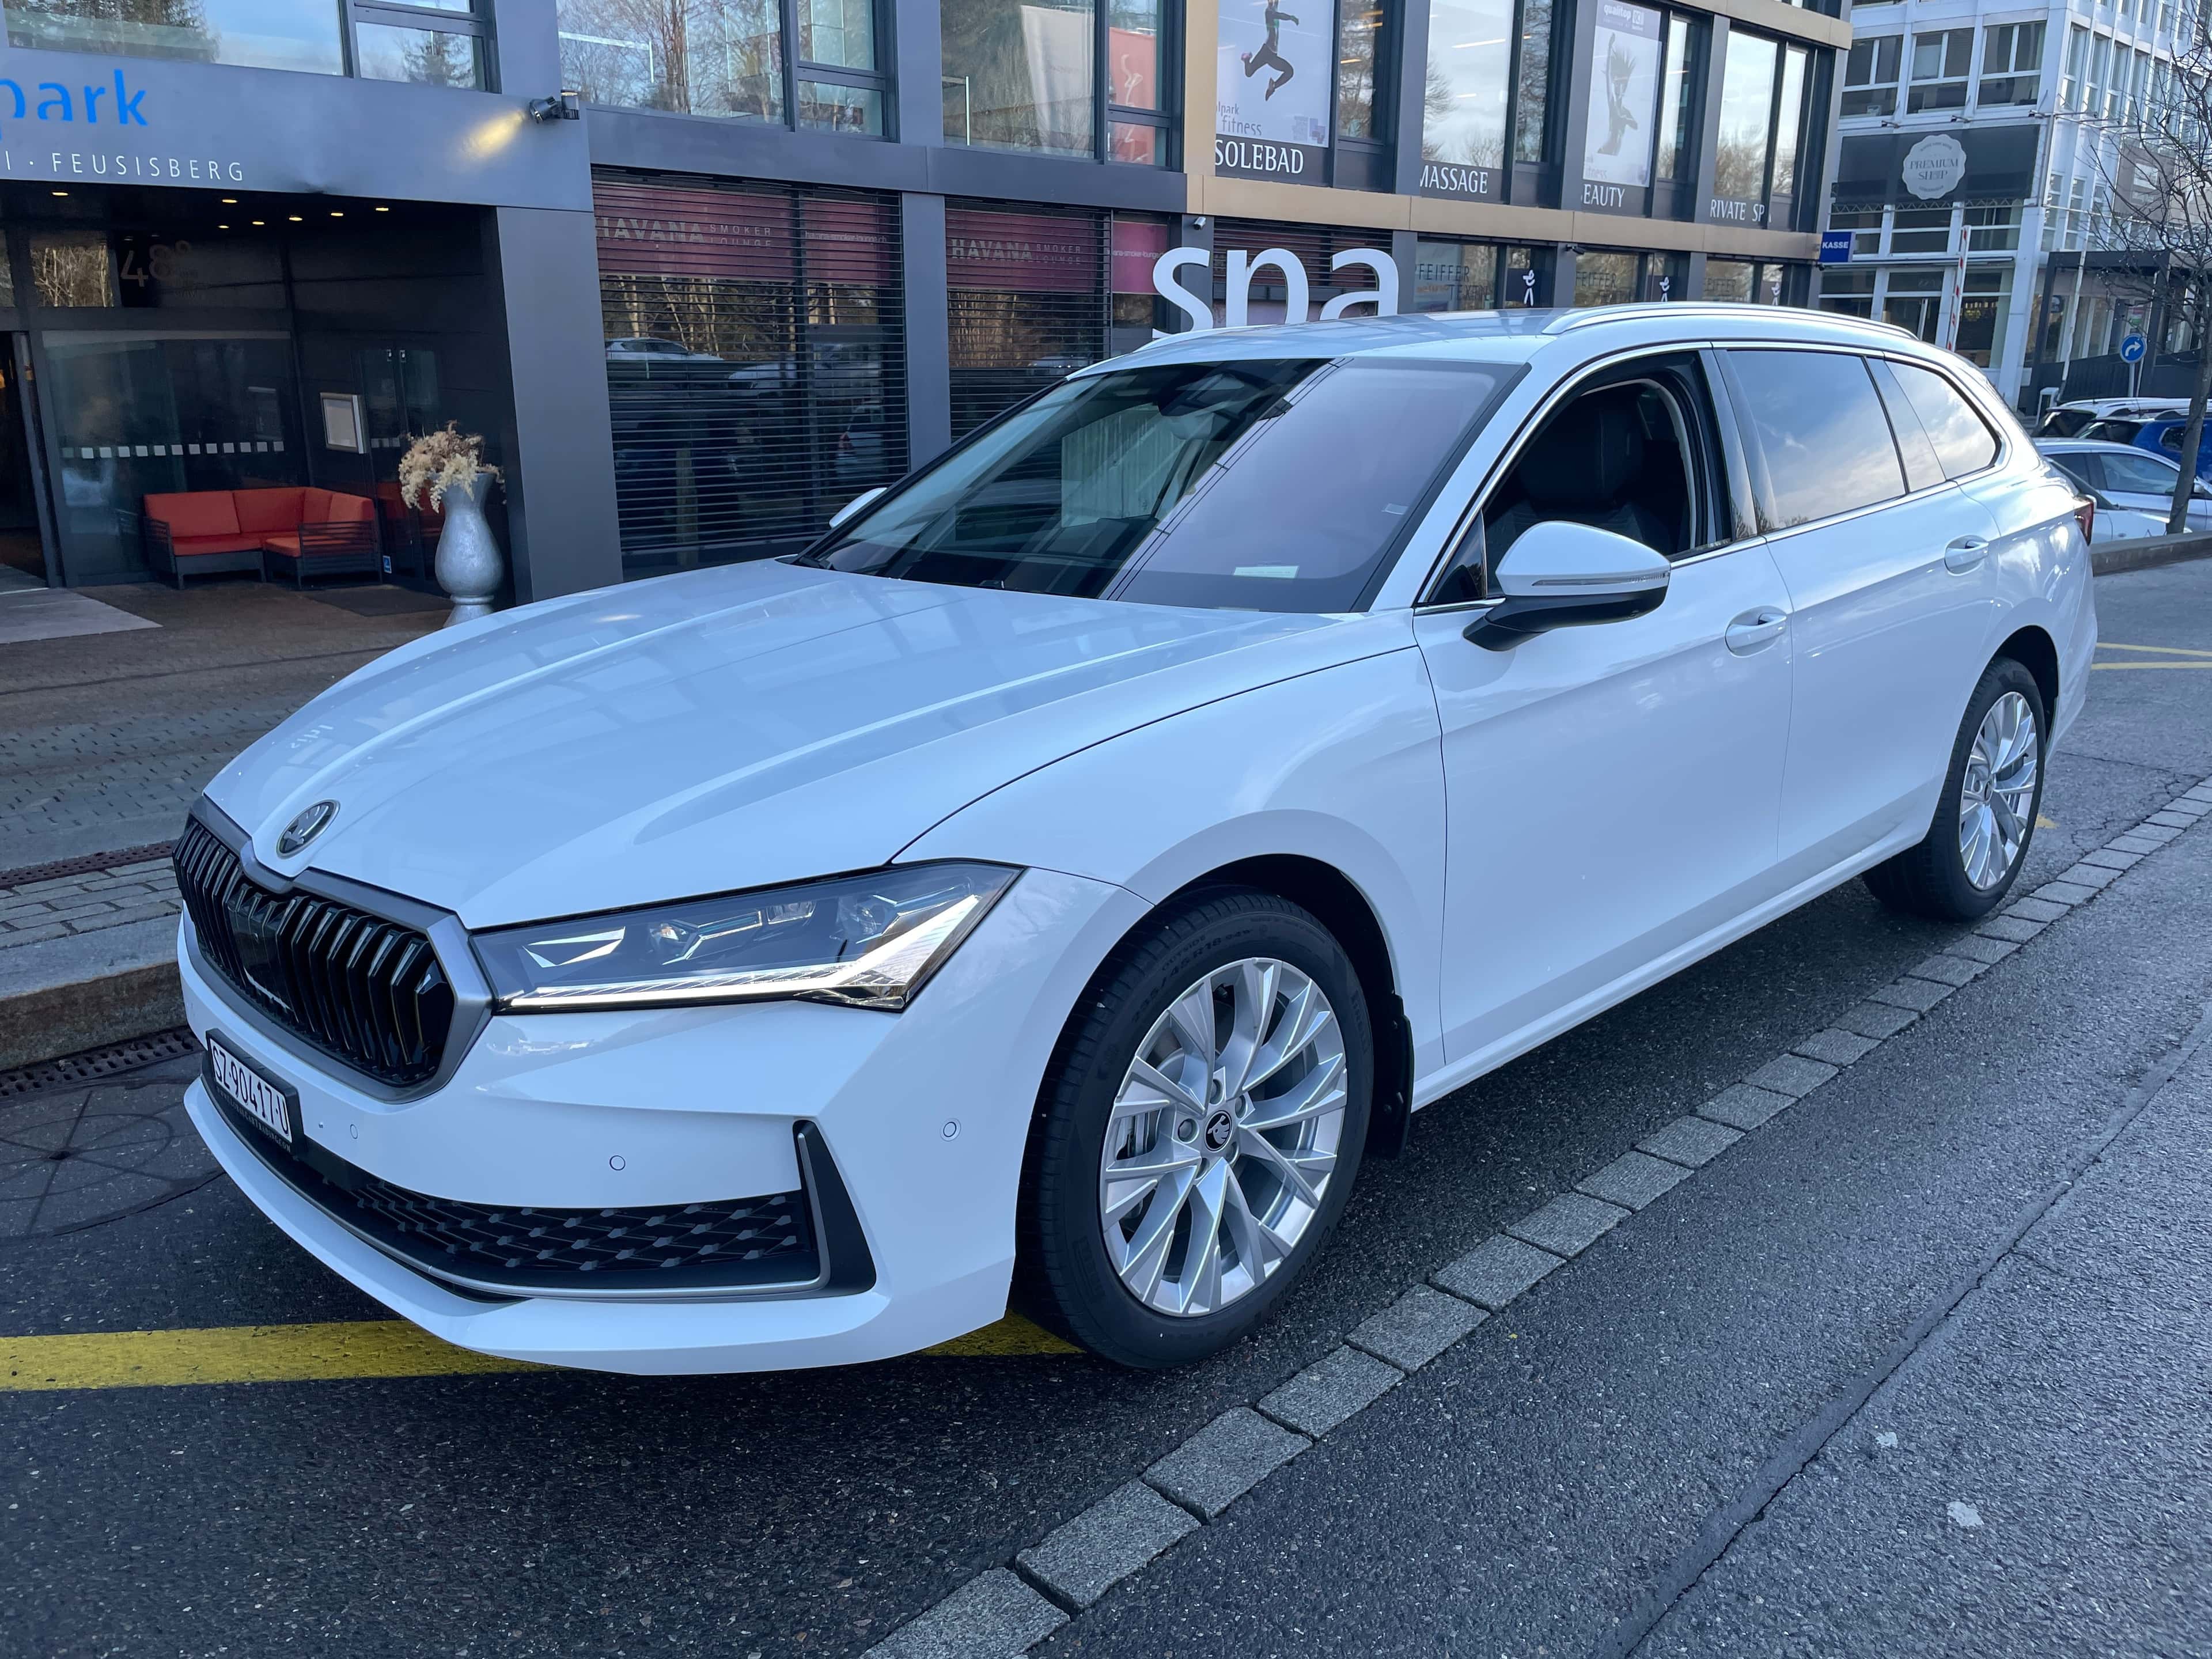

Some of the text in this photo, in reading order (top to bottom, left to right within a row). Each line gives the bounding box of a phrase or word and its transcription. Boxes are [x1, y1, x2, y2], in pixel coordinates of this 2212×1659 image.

[1222, 115, 1263, 136] fitness
[52, 152, 244, 181] FEUSISBERG
[1215, 139, 1304, 173] SOLEBAD
[1581, 184, 1626, 208] EAUTY
[1710, 199, 1747, 221] RIVATE
[710, 224, 772, 236] SMOKER
[951, 238, 1033, 263] HAVANA
[1822, 241, 1849, 249] KASSE
